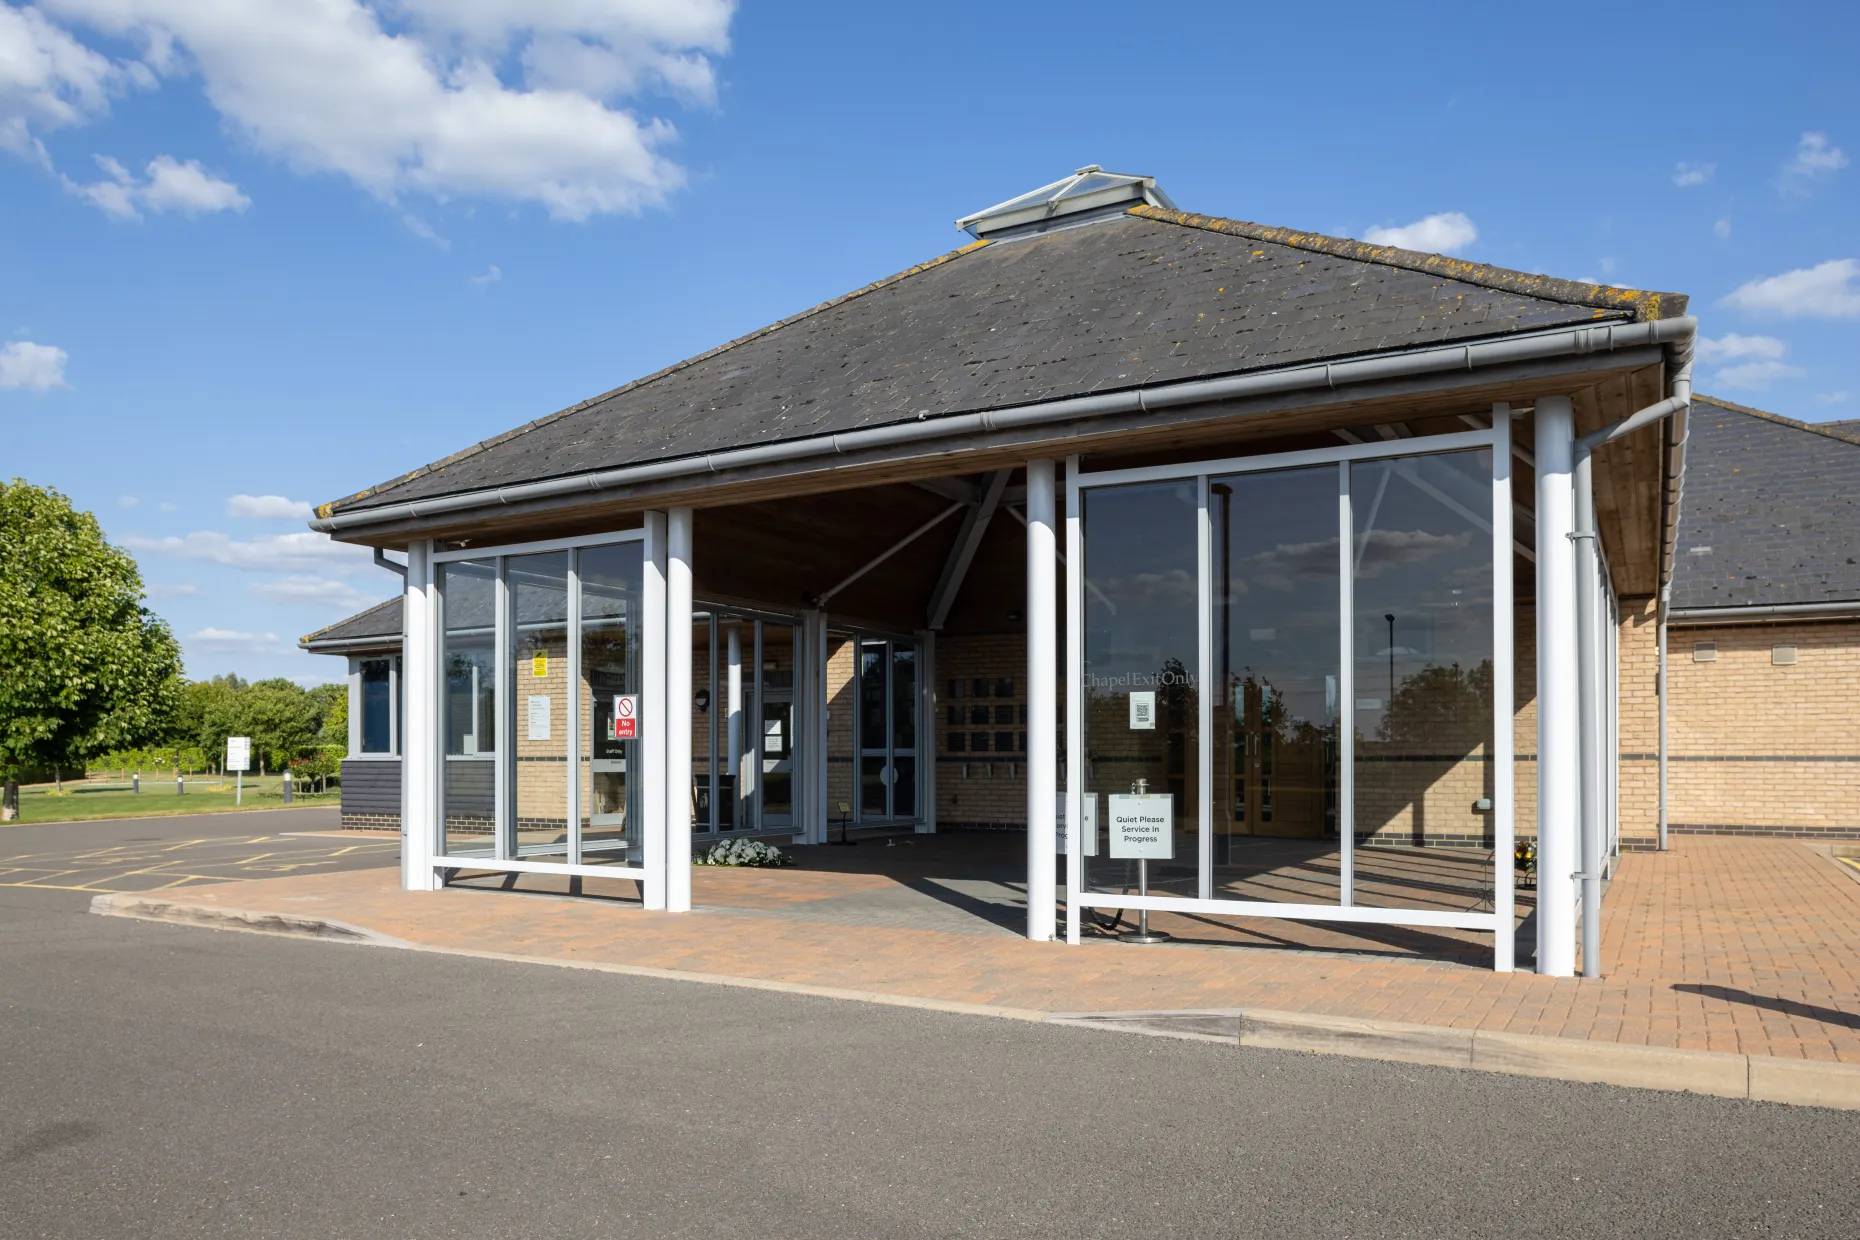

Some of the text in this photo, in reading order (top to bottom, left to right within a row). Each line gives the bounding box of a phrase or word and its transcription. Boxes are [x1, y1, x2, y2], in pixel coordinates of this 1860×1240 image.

[1083, 670, 1198, 690] Chapel Exit Only
[618, 728, 632, 736] entry
[1124, 835, 1158, 844] Progress
